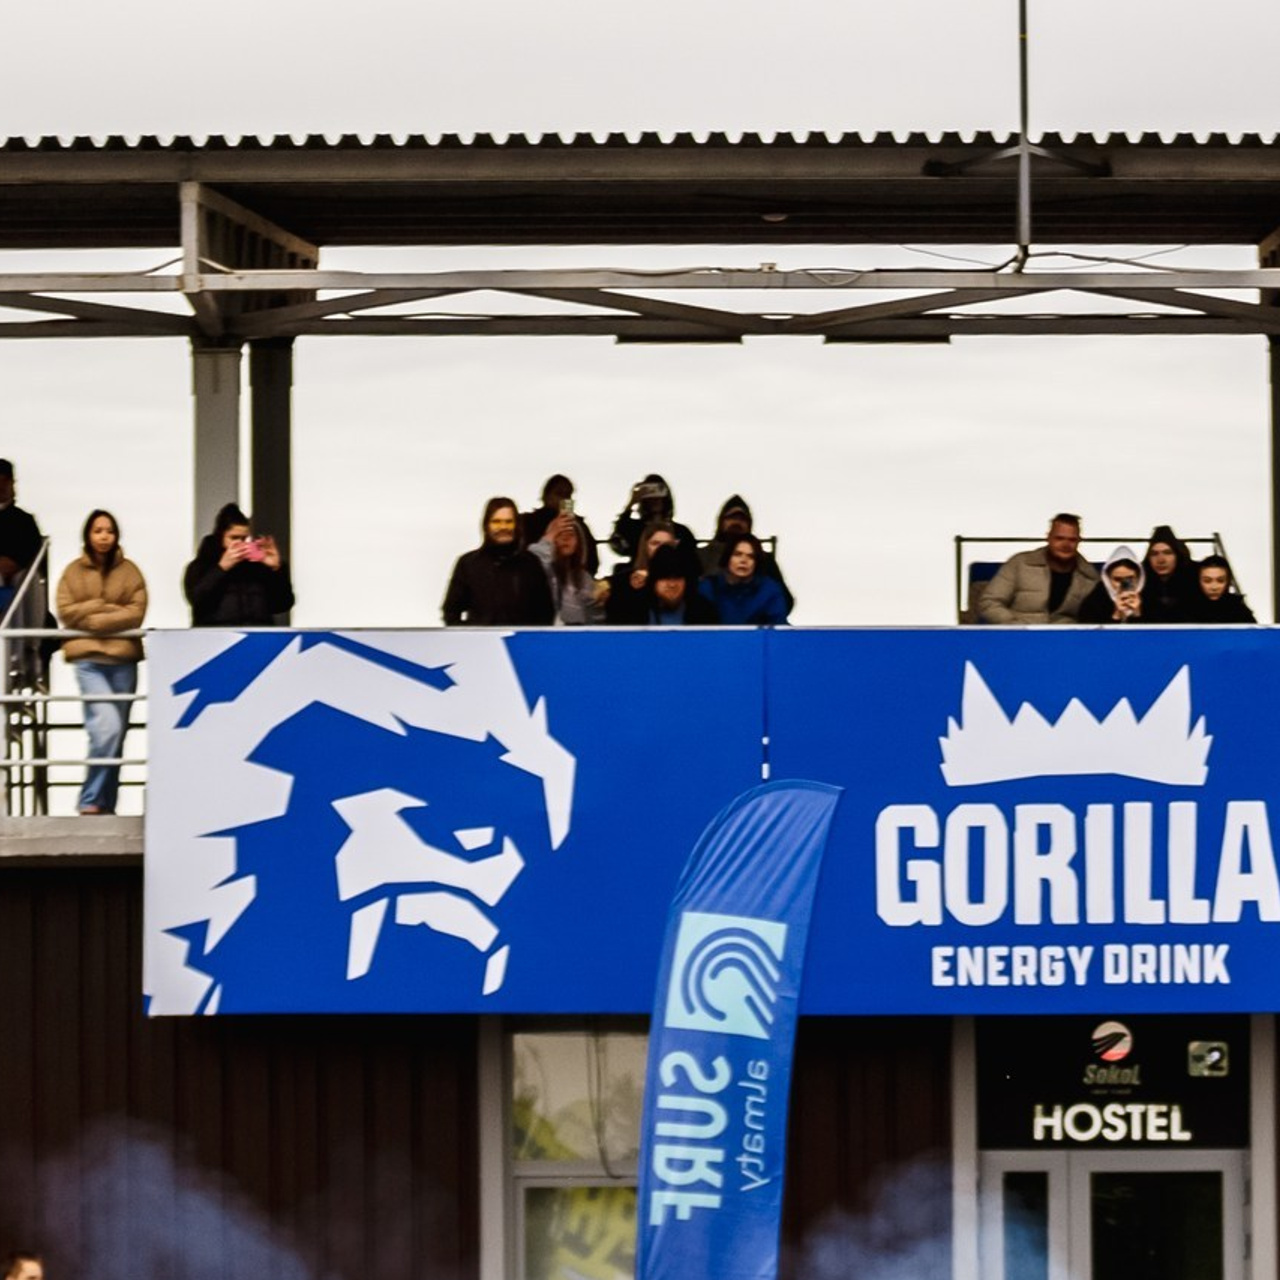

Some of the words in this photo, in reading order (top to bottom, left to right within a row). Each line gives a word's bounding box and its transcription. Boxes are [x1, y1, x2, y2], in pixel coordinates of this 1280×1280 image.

[931, 945, 1094, 987] ENERGY
[1103, 944, 1231, 984] DRINK
[1033, 1103, 1193, 1141] HOSTEL
